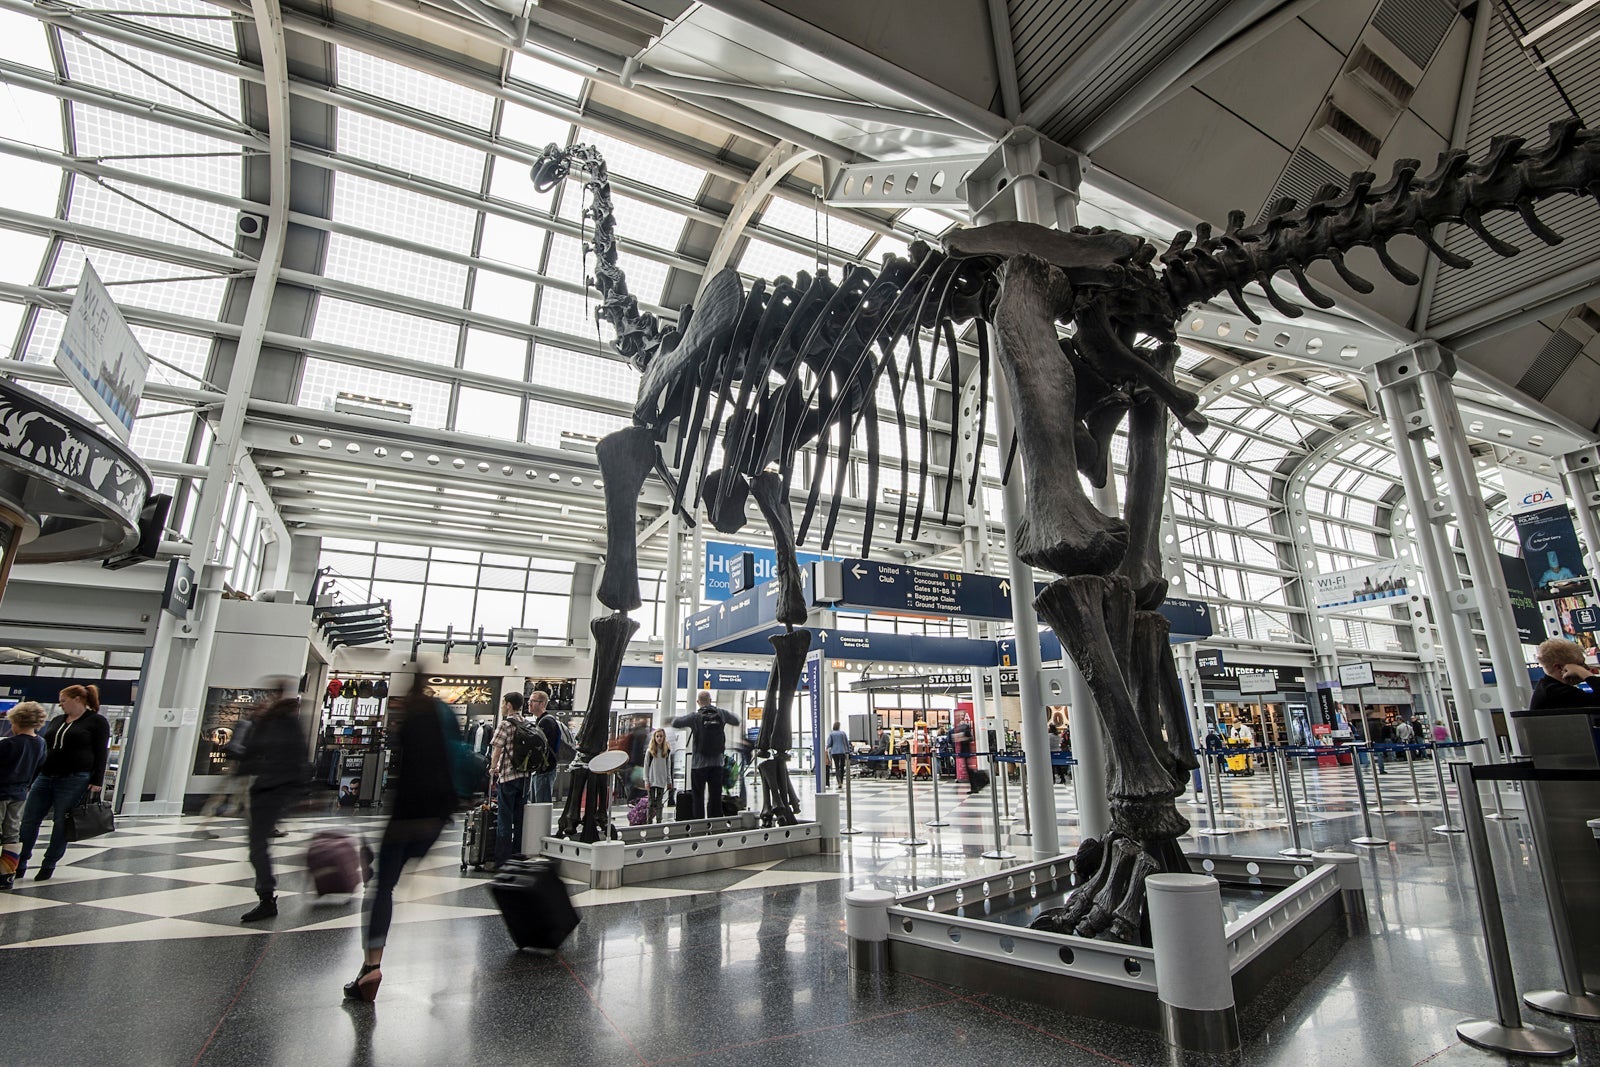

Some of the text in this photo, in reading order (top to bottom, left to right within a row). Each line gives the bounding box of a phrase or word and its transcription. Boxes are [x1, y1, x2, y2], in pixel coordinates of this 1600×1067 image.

[1523, 491, 1553, 505] CDA
[878, 565, 899, 575] United
[914, 569, 938, 578] Terminals
[879, 575, 894, 583] Club
[914, 577, 945, 587] Concourses
[1318, 576, 1346, 587] WI-FI
[914, 585, 930, 593] Gates
[1319, 584, 1347, 593] AVAILABLE
[914, 593, 938, 602] Baggage
[937, 603, 961, 612] Transport
[928, 674, 991, 683] STARBUS
